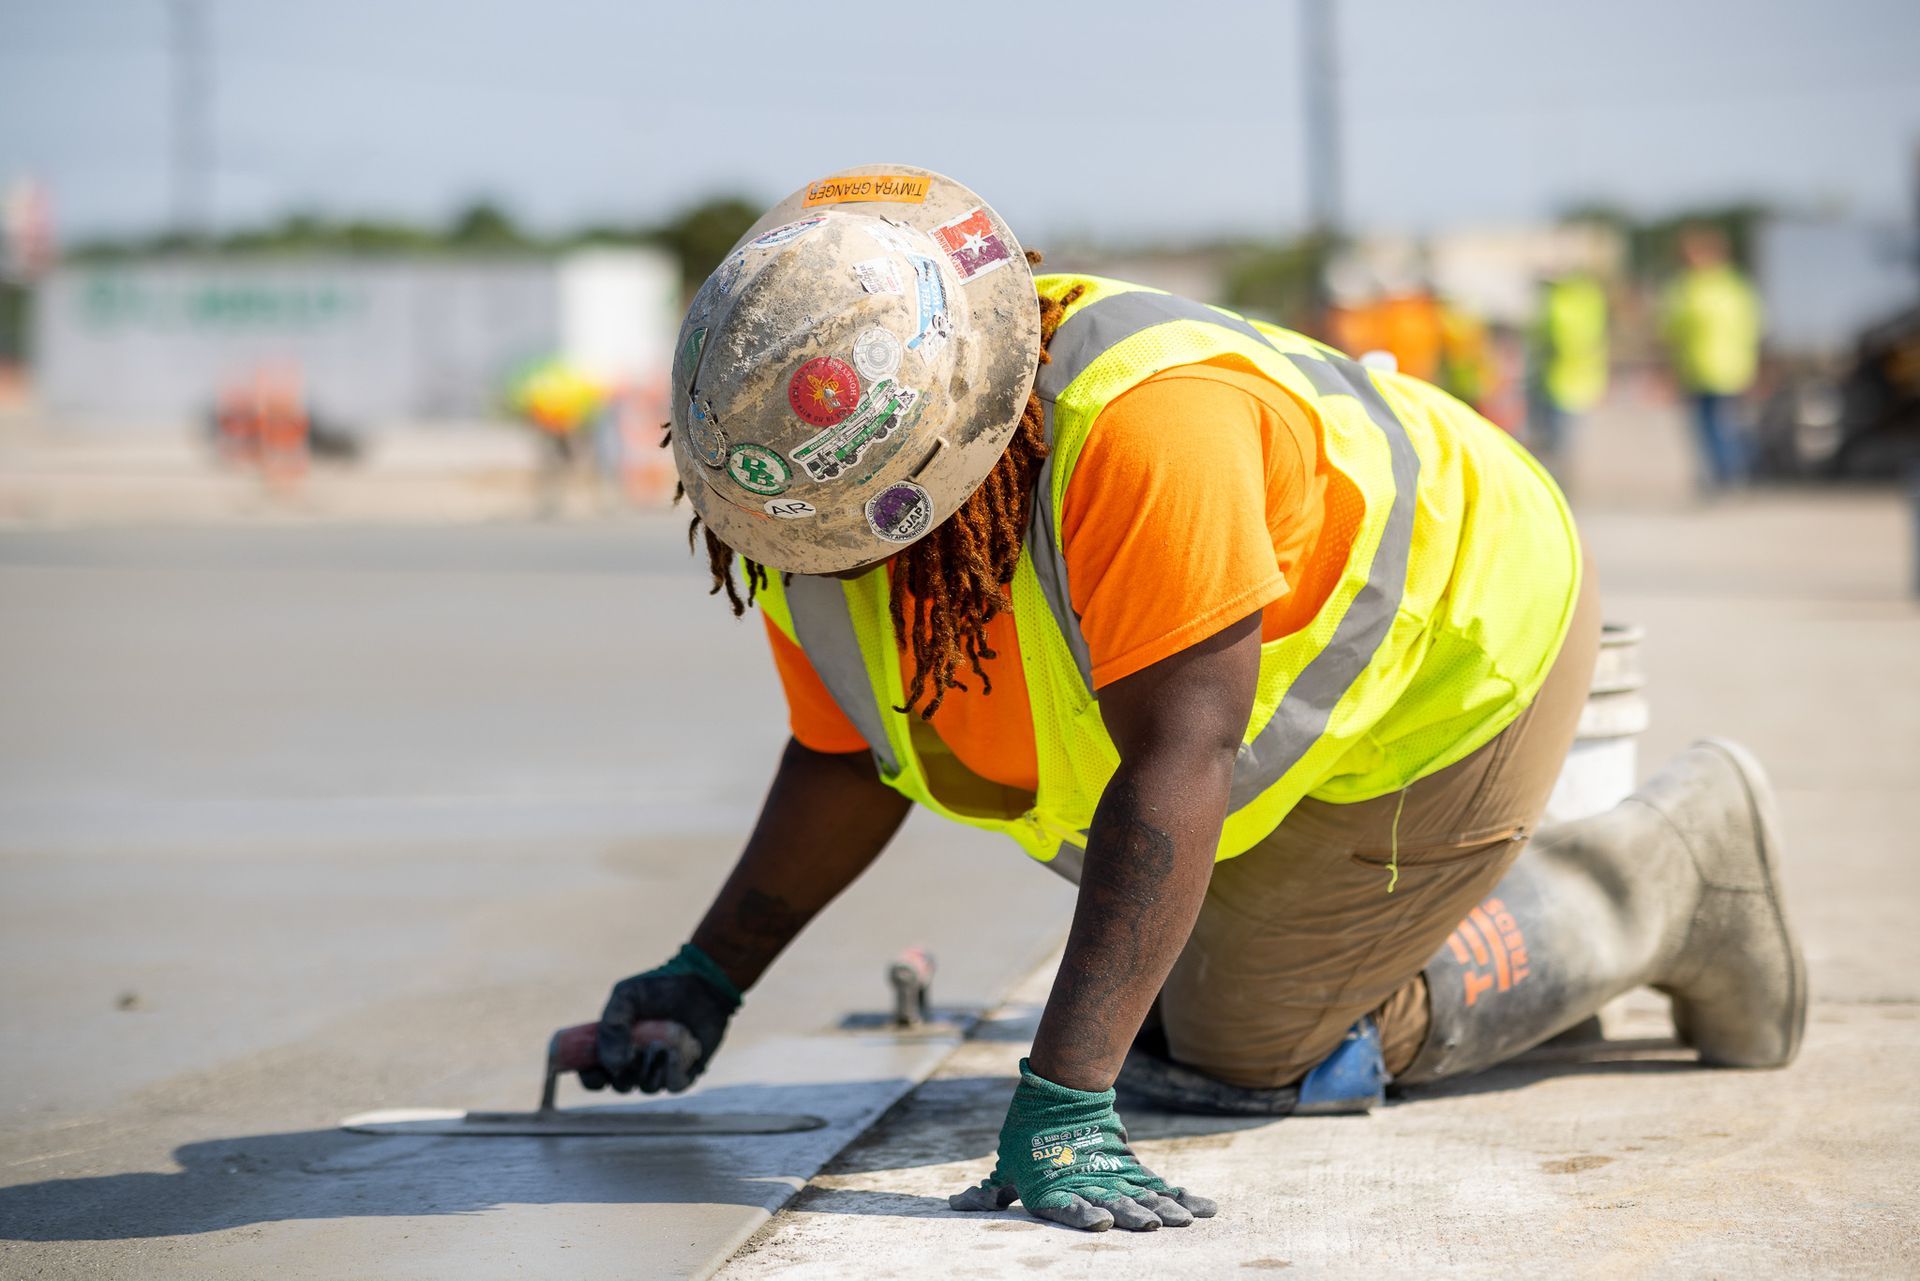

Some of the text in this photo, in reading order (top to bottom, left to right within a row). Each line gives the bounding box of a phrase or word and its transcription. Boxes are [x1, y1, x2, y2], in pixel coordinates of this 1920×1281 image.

[808, 181, 872, 200] GRANGER
[828, 359, 857, 396] HONEYBEE
[771, 502, 815, 516] AR
[898, 506, 923, 534] CJAP
